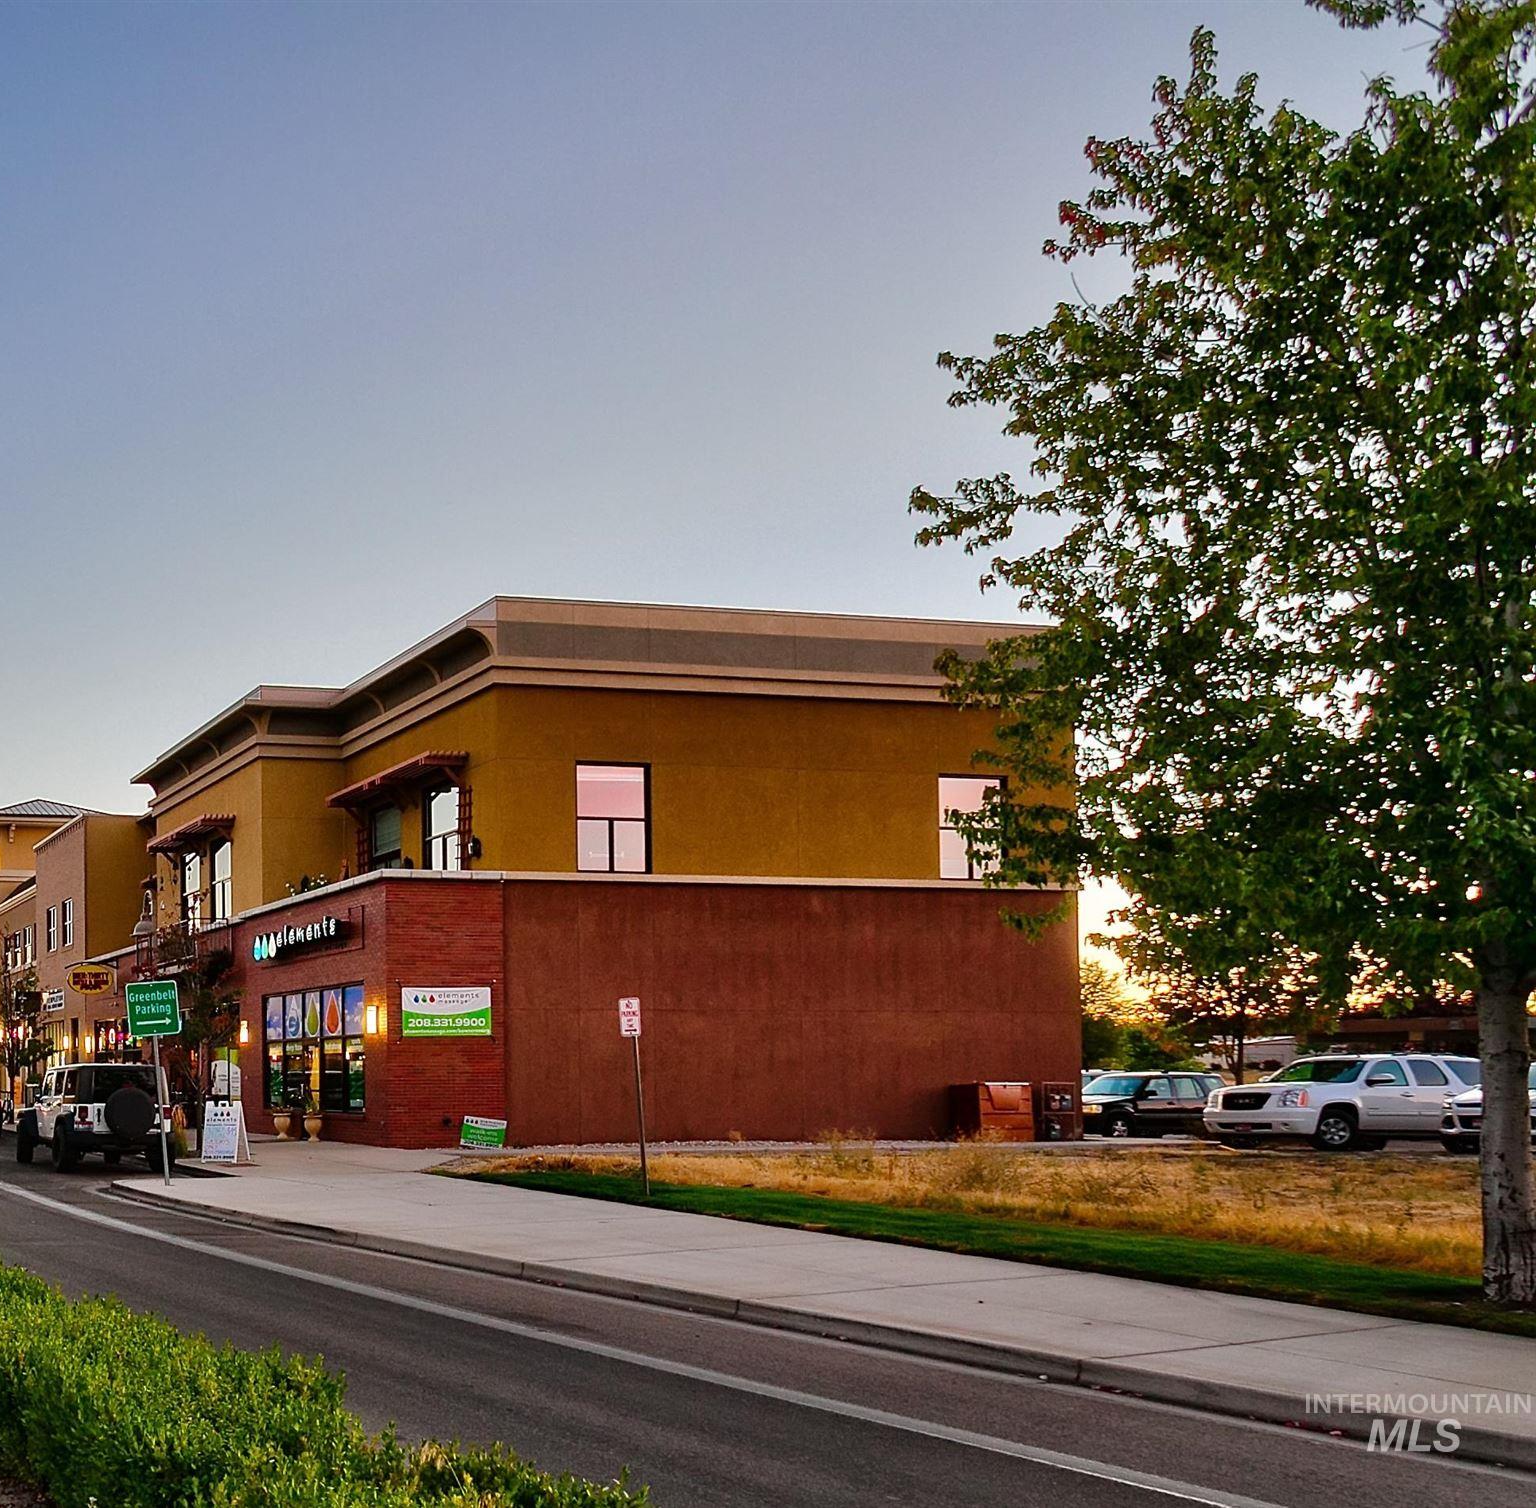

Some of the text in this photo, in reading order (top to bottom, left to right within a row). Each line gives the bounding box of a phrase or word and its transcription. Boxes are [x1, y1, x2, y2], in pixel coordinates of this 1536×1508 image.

[275, 915, 336, 948] elements
[129, 989, 176, 1003] Greenbelt
[135, 1003, 171, 1015] Parking
[625, 1001, 633, 1010] NO
[408, 1017, 486, 1027] 208.331.9900
